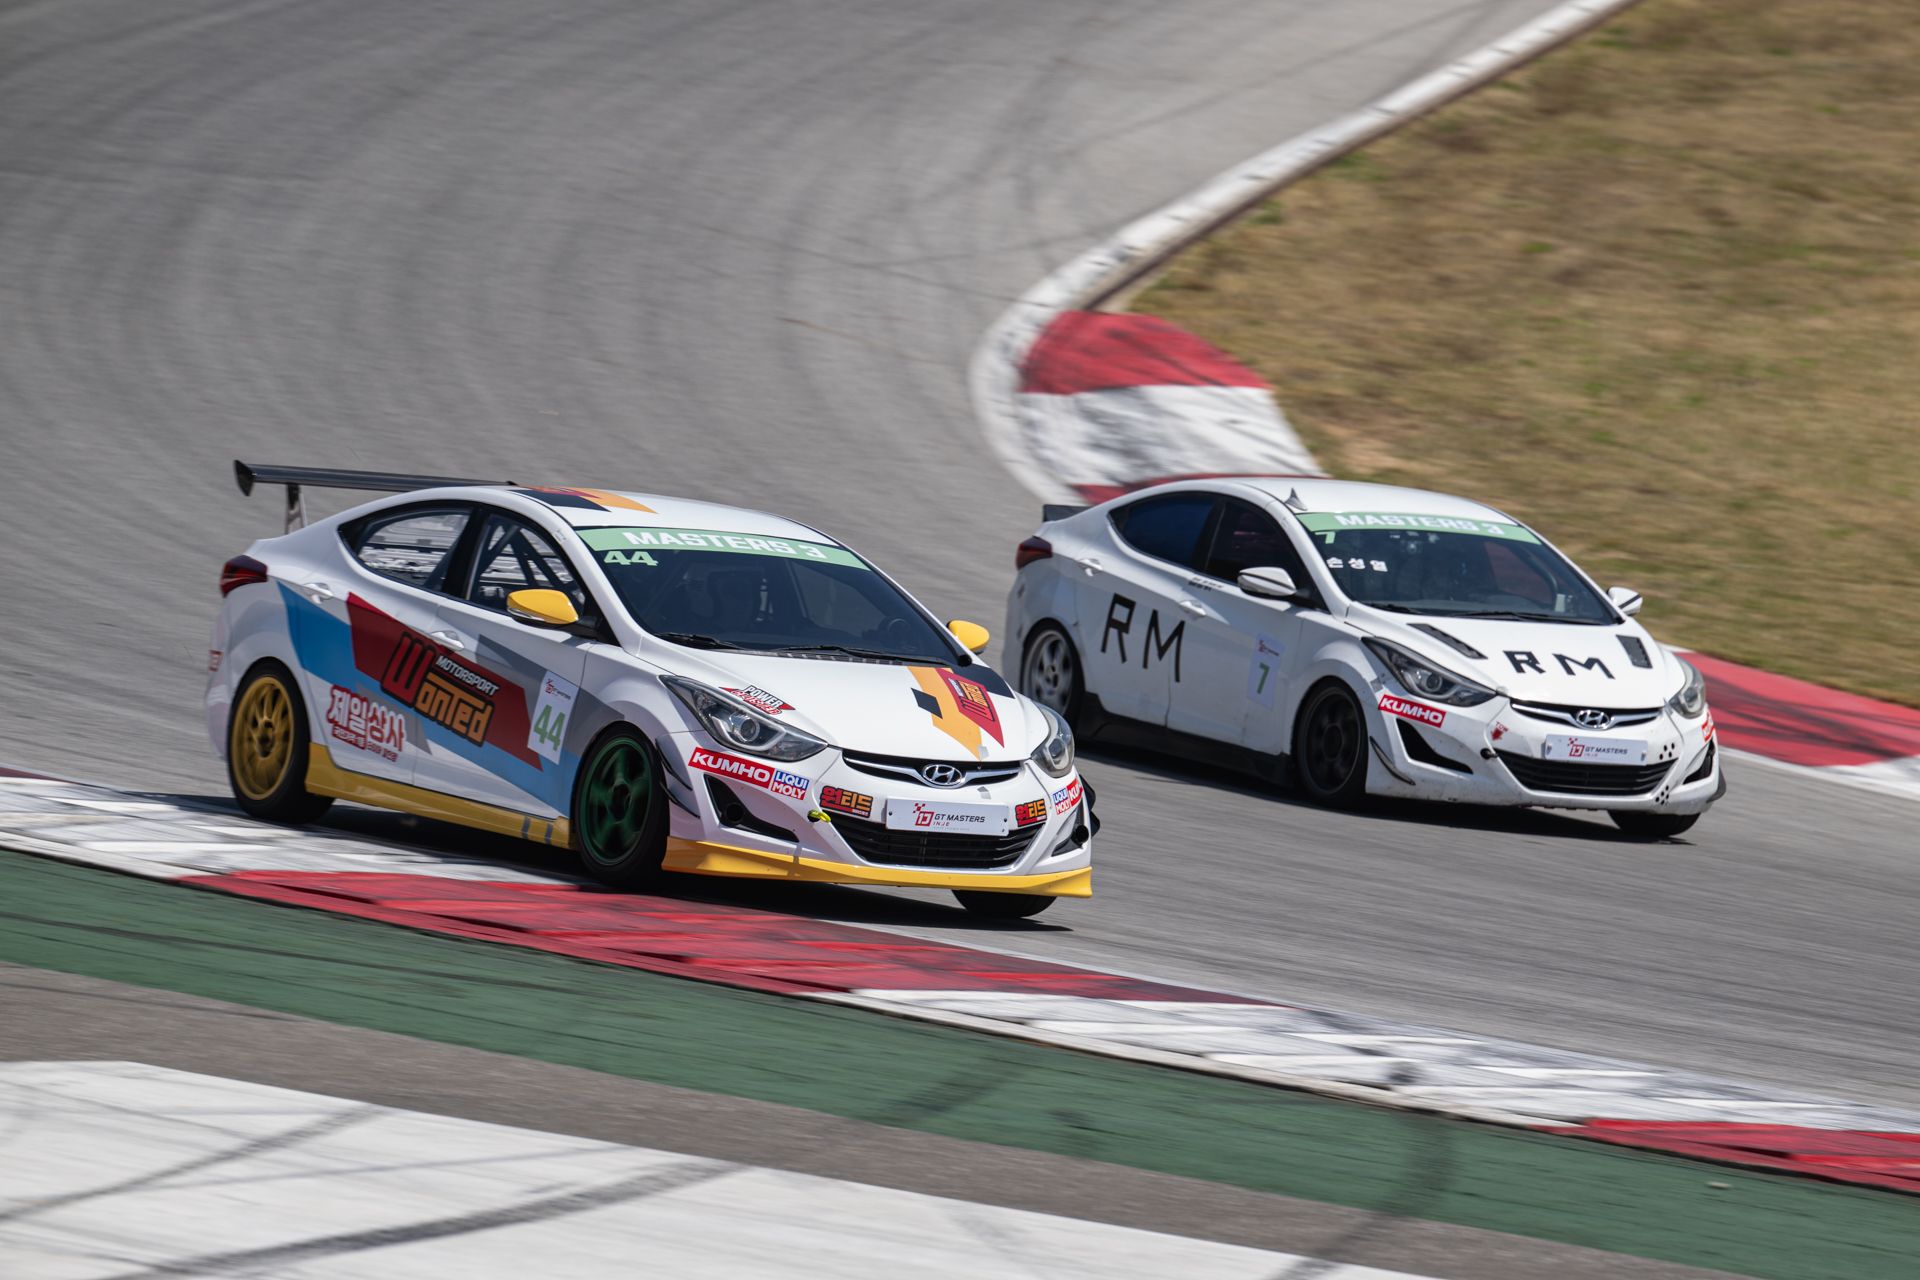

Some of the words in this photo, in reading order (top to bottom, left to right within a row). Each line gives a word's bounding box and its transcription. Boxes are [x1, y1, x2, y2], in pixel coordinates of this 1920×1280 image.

[1315, 531, 1336, 545] 7
[1334, 515, 1479, 532] MASTERS
[1482, 522, 1505, 535] 3
[604, 550, 659, 566] 44
[622, 532, 796, 555] MASTERS
[798, 545, 828, 560] 3
[1101, 592, 1186, 683] RM
[435, 655, 500, 696] MOTORSPORT
[1256, 662, 1271, 695] 7
[1502, 650, 1616, 680] RM
[744, 685, 784, 709] POWER
[1380, 697, 1443, 724] KUMHO
[328, 688, 407, 752] 제일상사
[533, 704, 566, 752] 44
[1595, 746, 1628, 755] MASTERS
[693, 752, 771, 783] KUMHO
[775, 770, 809, 790] LIQUI
[772, 781, 806, 799] MOLY
[934, 813, 948, 821] GT
[947, 814, 986, 823] MASTERS
